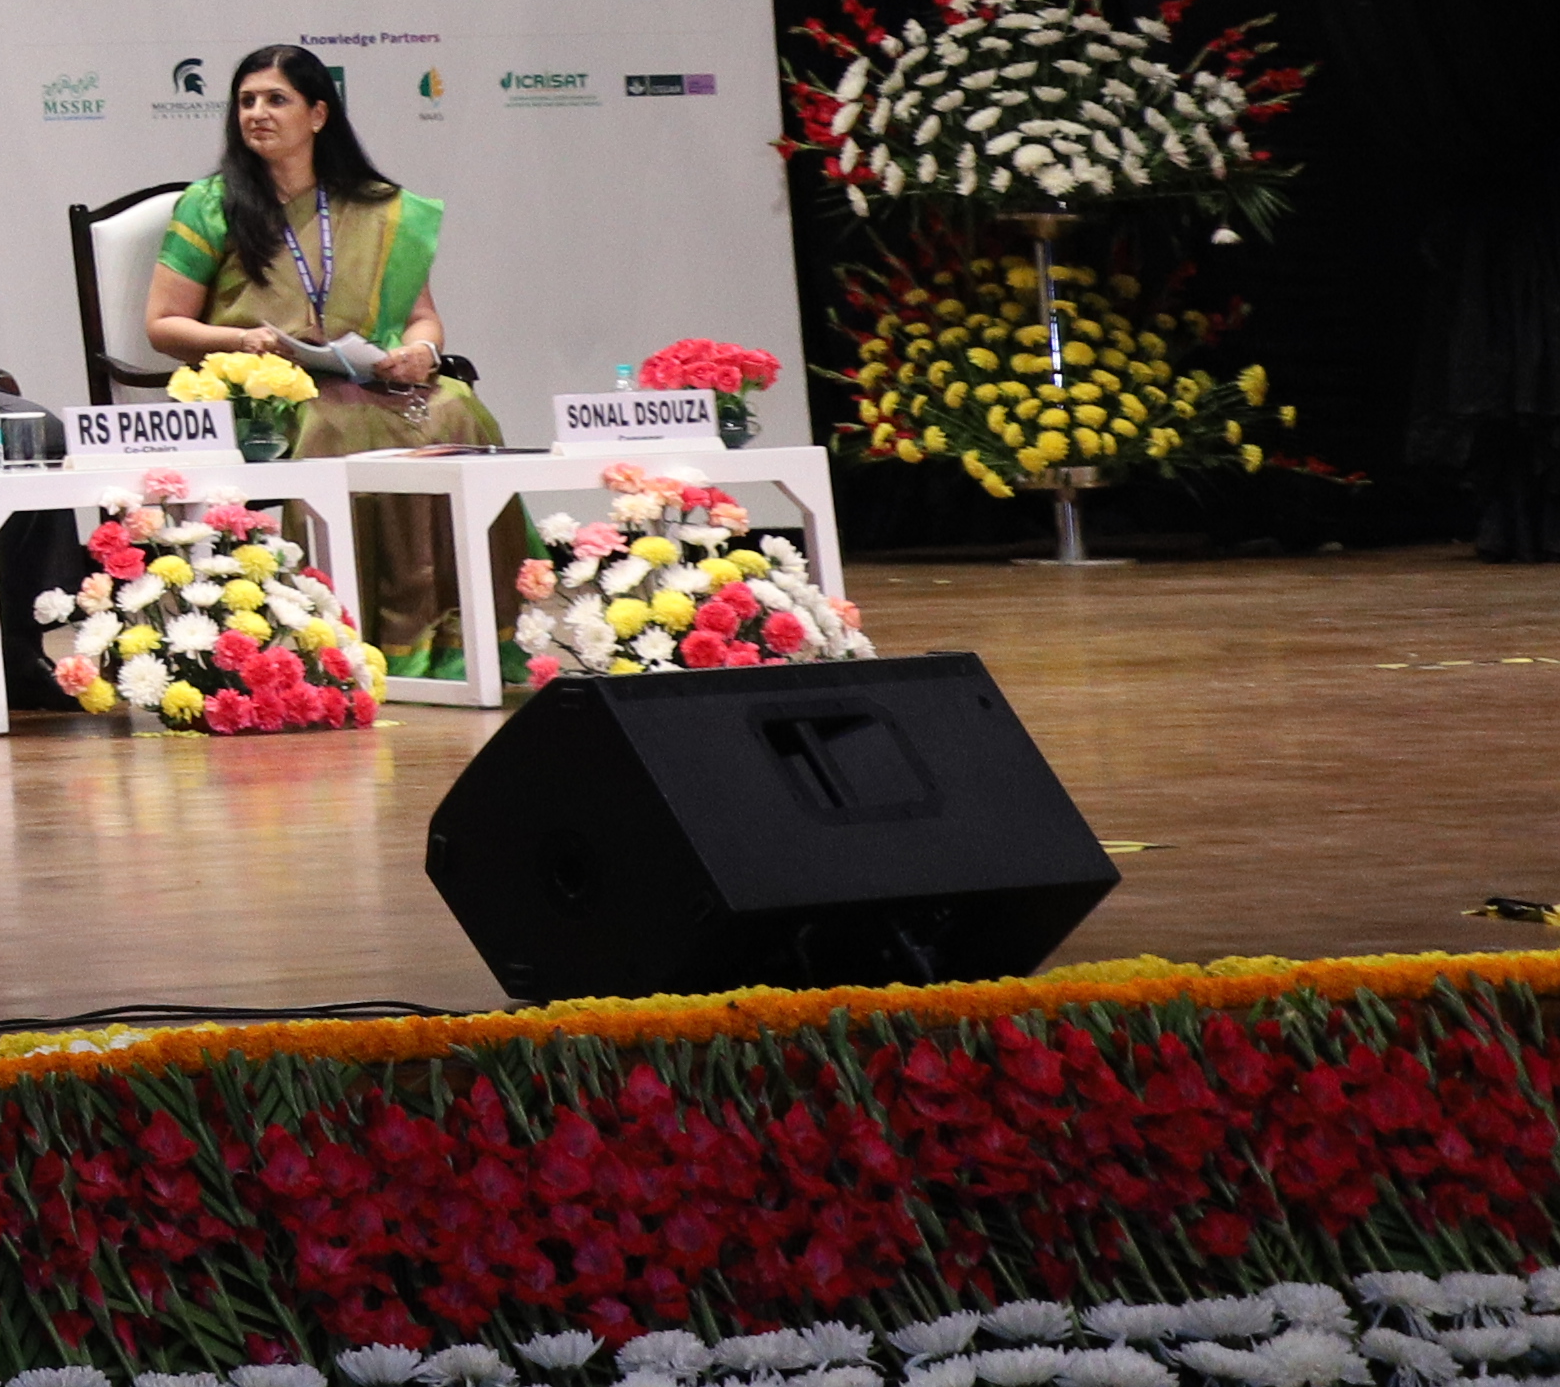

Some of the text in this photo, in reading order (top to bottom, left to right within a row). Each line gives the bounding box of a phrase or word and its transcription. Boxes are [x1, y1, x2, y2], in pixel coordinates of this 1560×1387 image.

[300, 31, 440, 47] Knowledge Partners
[43, 100, 105, 115] MSSRF
[567, 399, 710, 429] SONAL DSOUZA
[78, 408, 218, 445] RS PARODA
